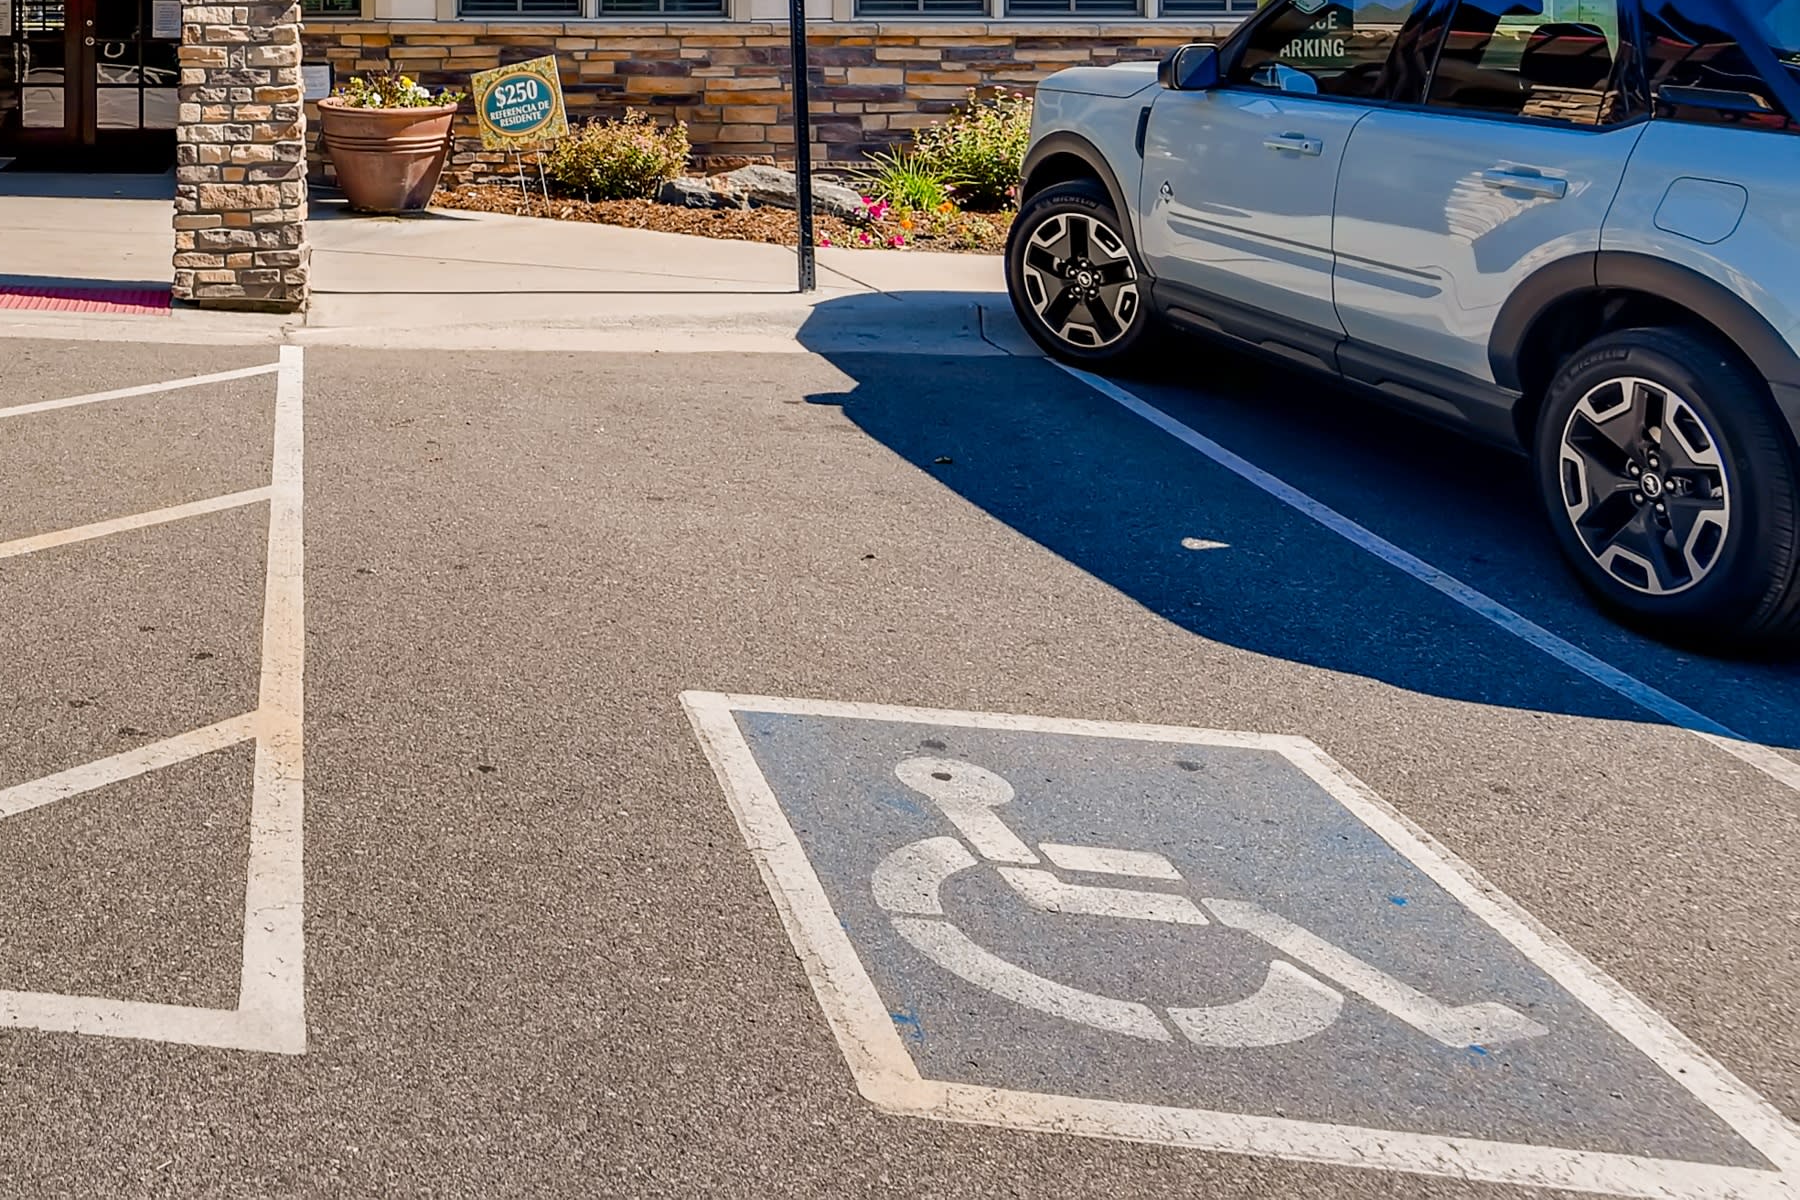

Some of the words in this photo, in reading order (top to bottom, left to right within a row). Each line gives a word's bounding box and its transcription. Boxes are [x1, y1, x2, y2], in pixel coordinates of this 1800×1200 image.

[1280, 38, 1345, 58] ARKING
[494, 79, 538, 109] $250
[489, 104, 537, 121] REFERENCIA
[537, 100, 550, 110] DE
[499, 111, 543, 128] RESIDENTE
